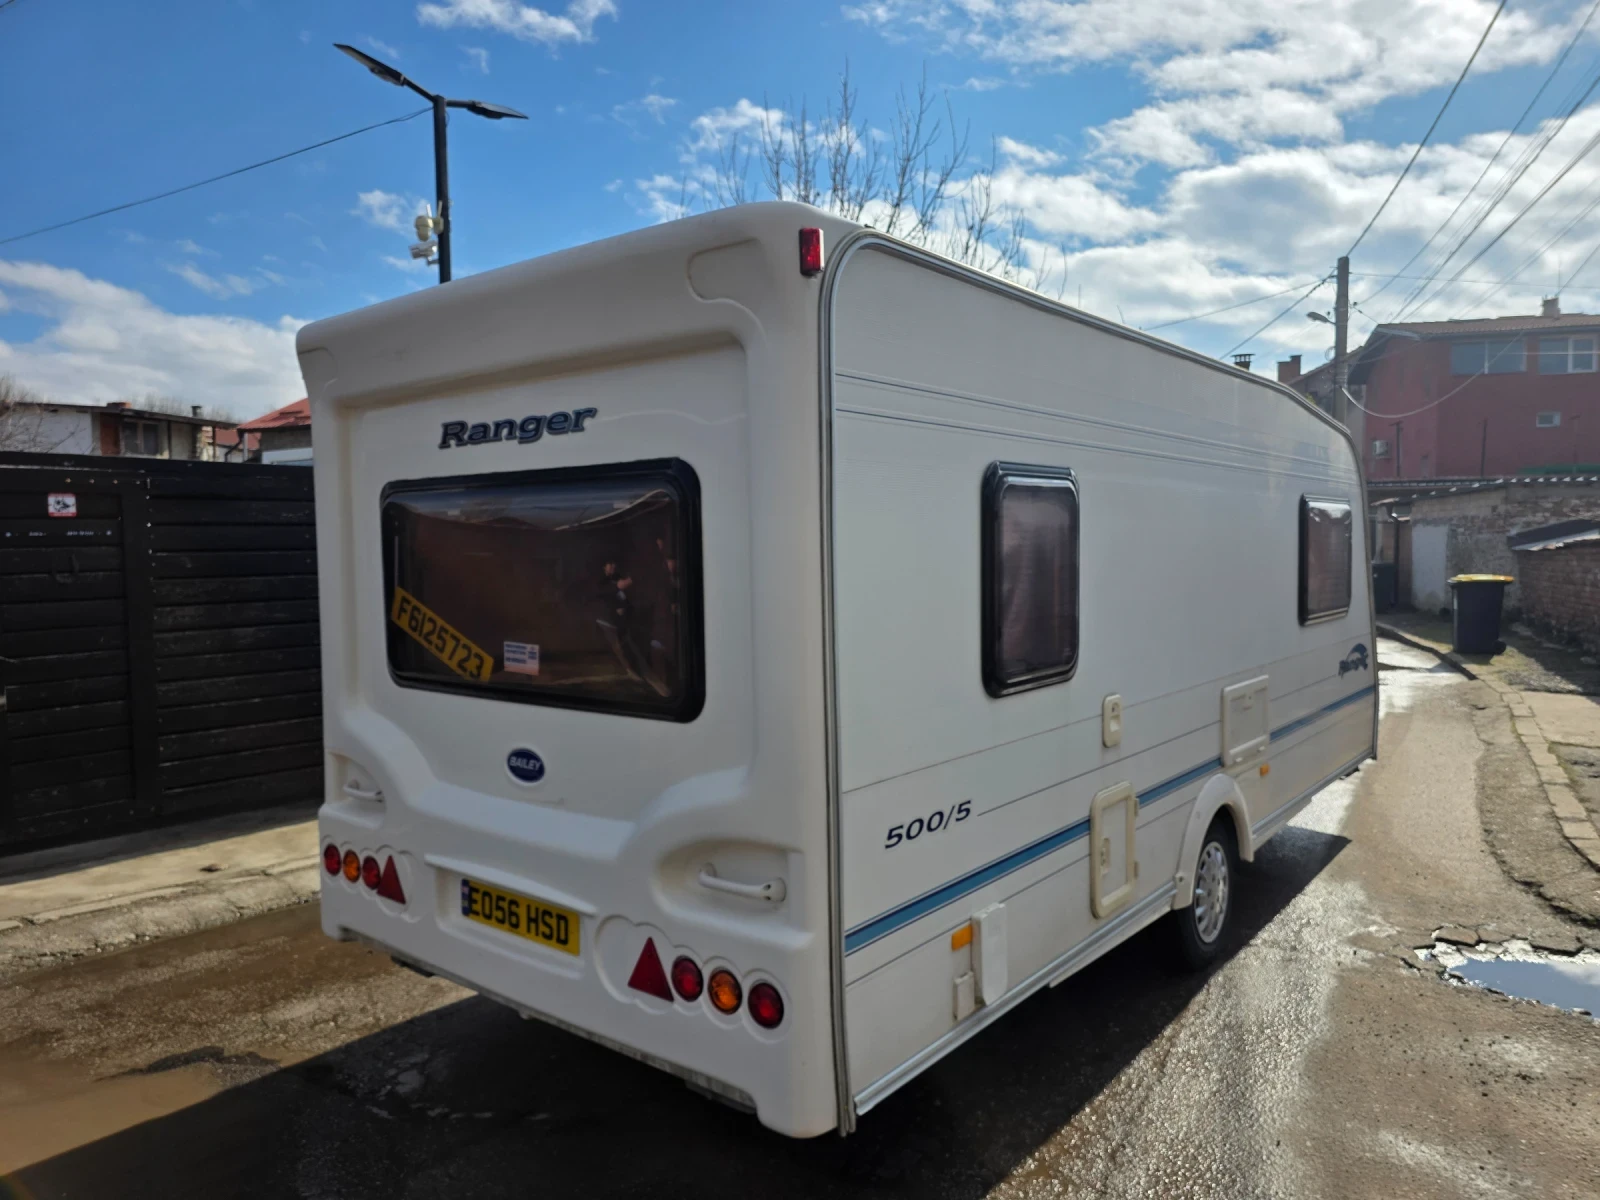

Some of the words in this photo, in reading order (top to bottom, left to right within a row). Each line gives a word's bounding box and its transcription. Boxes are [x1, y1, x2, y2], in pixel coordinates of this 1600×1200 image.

[438, 407, 598, 450] Ranger
[509, 755, 541, 770] BAILEY
[884, 799, 972, 849] 500/5
[526, 903, 570, 946] HSD
